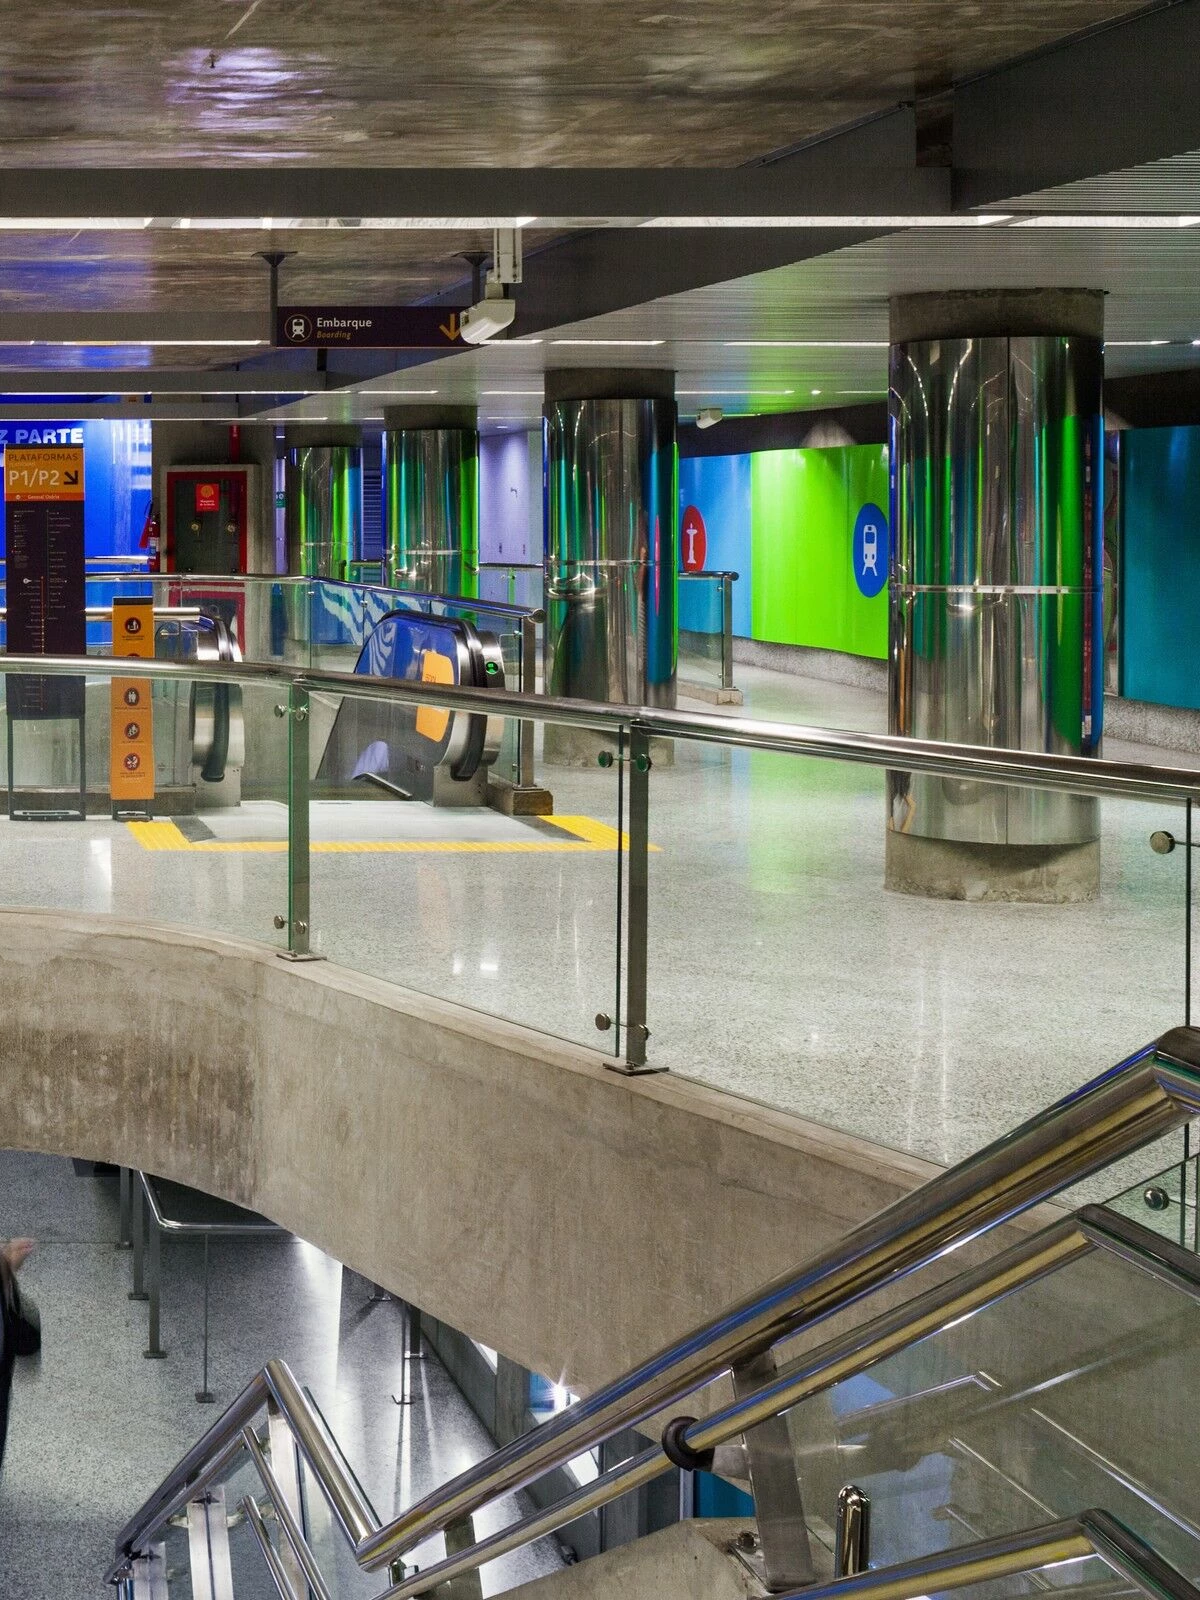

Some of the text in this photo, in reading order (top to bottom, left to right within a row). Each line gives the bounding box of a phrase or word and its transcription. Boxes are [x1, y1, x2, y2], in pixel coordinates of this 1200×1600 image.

[317, 317, 372, 329] Embarque
[316, 331, 351, 340] Boarding
[15, 428, 84, 443] PARTE
[8, 453, 79, 462] PLATAFORMAS
[9, 468, 60, 488] P1/P2
